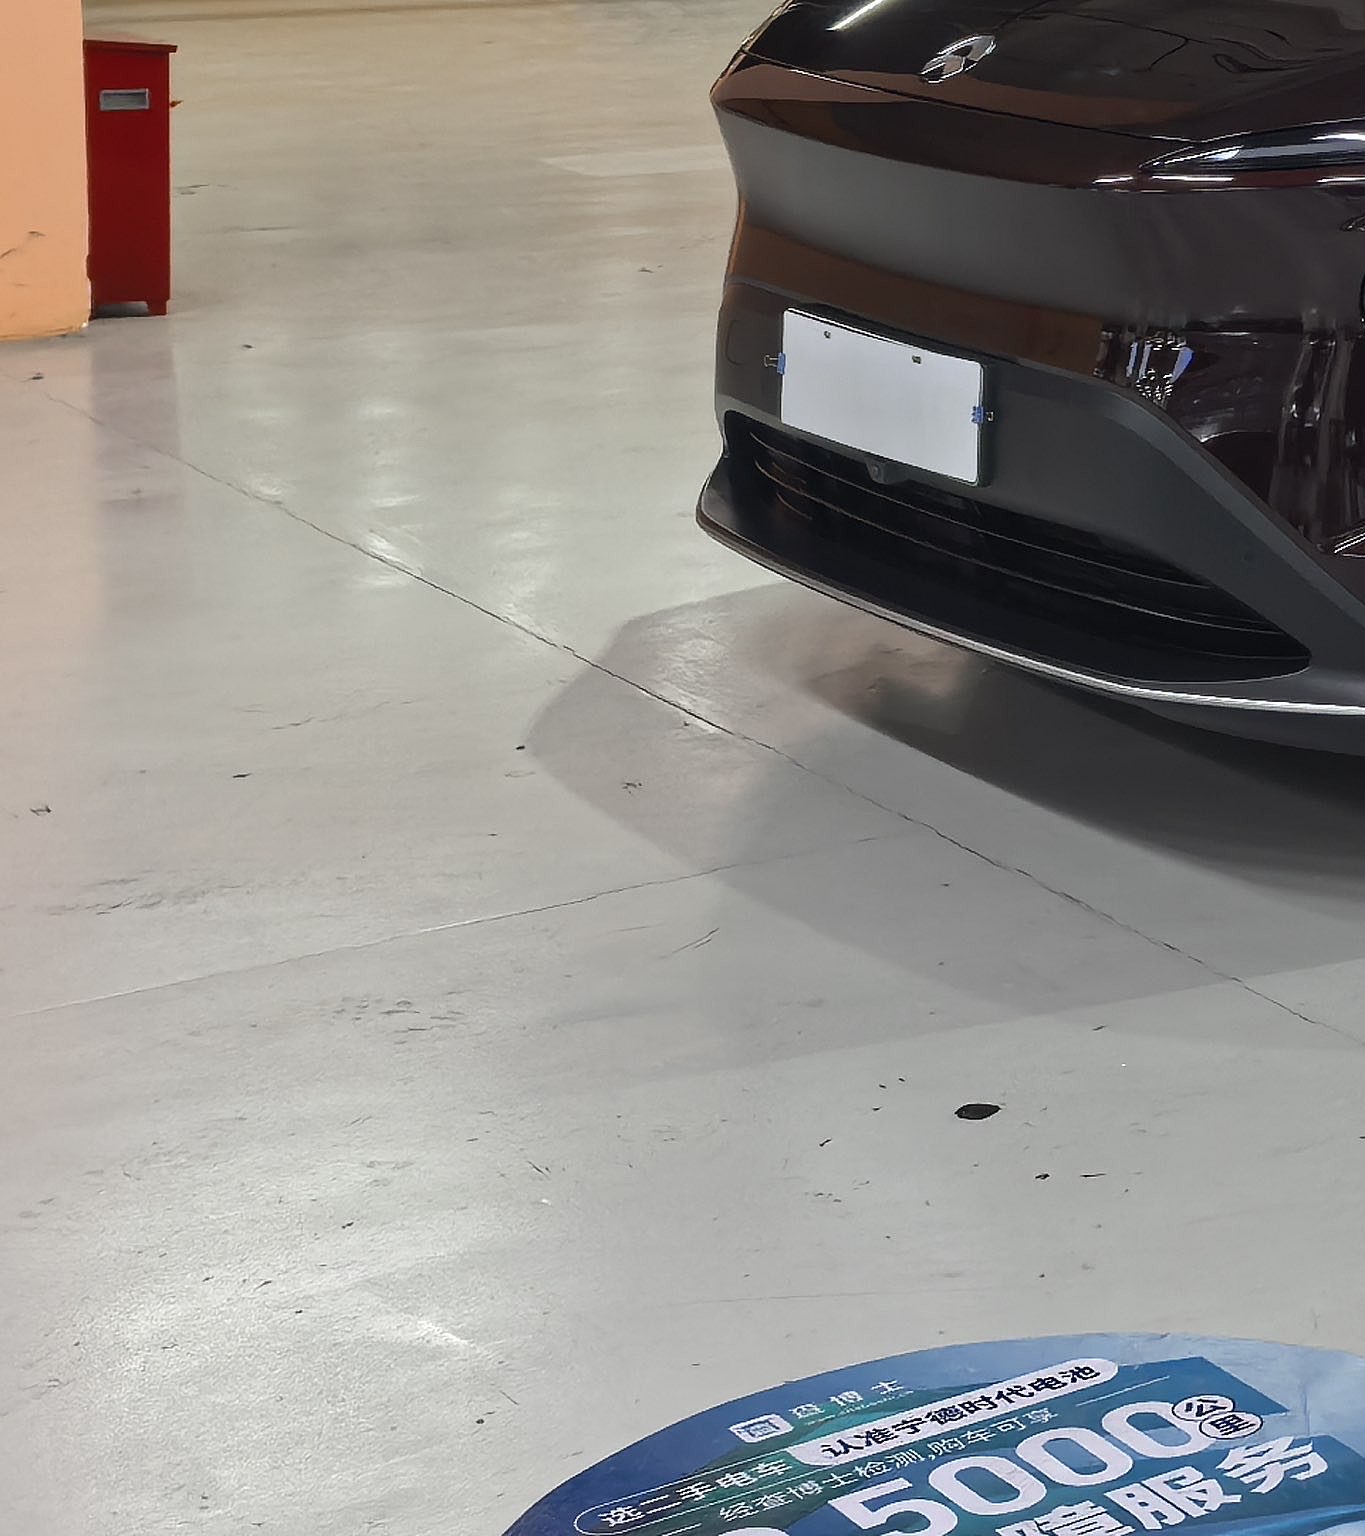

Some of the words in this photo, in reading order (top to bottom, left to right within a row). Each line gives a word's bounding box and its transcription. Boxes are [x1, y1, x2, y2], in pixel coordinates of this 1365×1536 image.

[821, 1365, 1101, 1458] 认准宁德时代电池
[1184, 1398, 1256, 1436] 公里
[597, 1459, 793, 1527] 选二手电车
